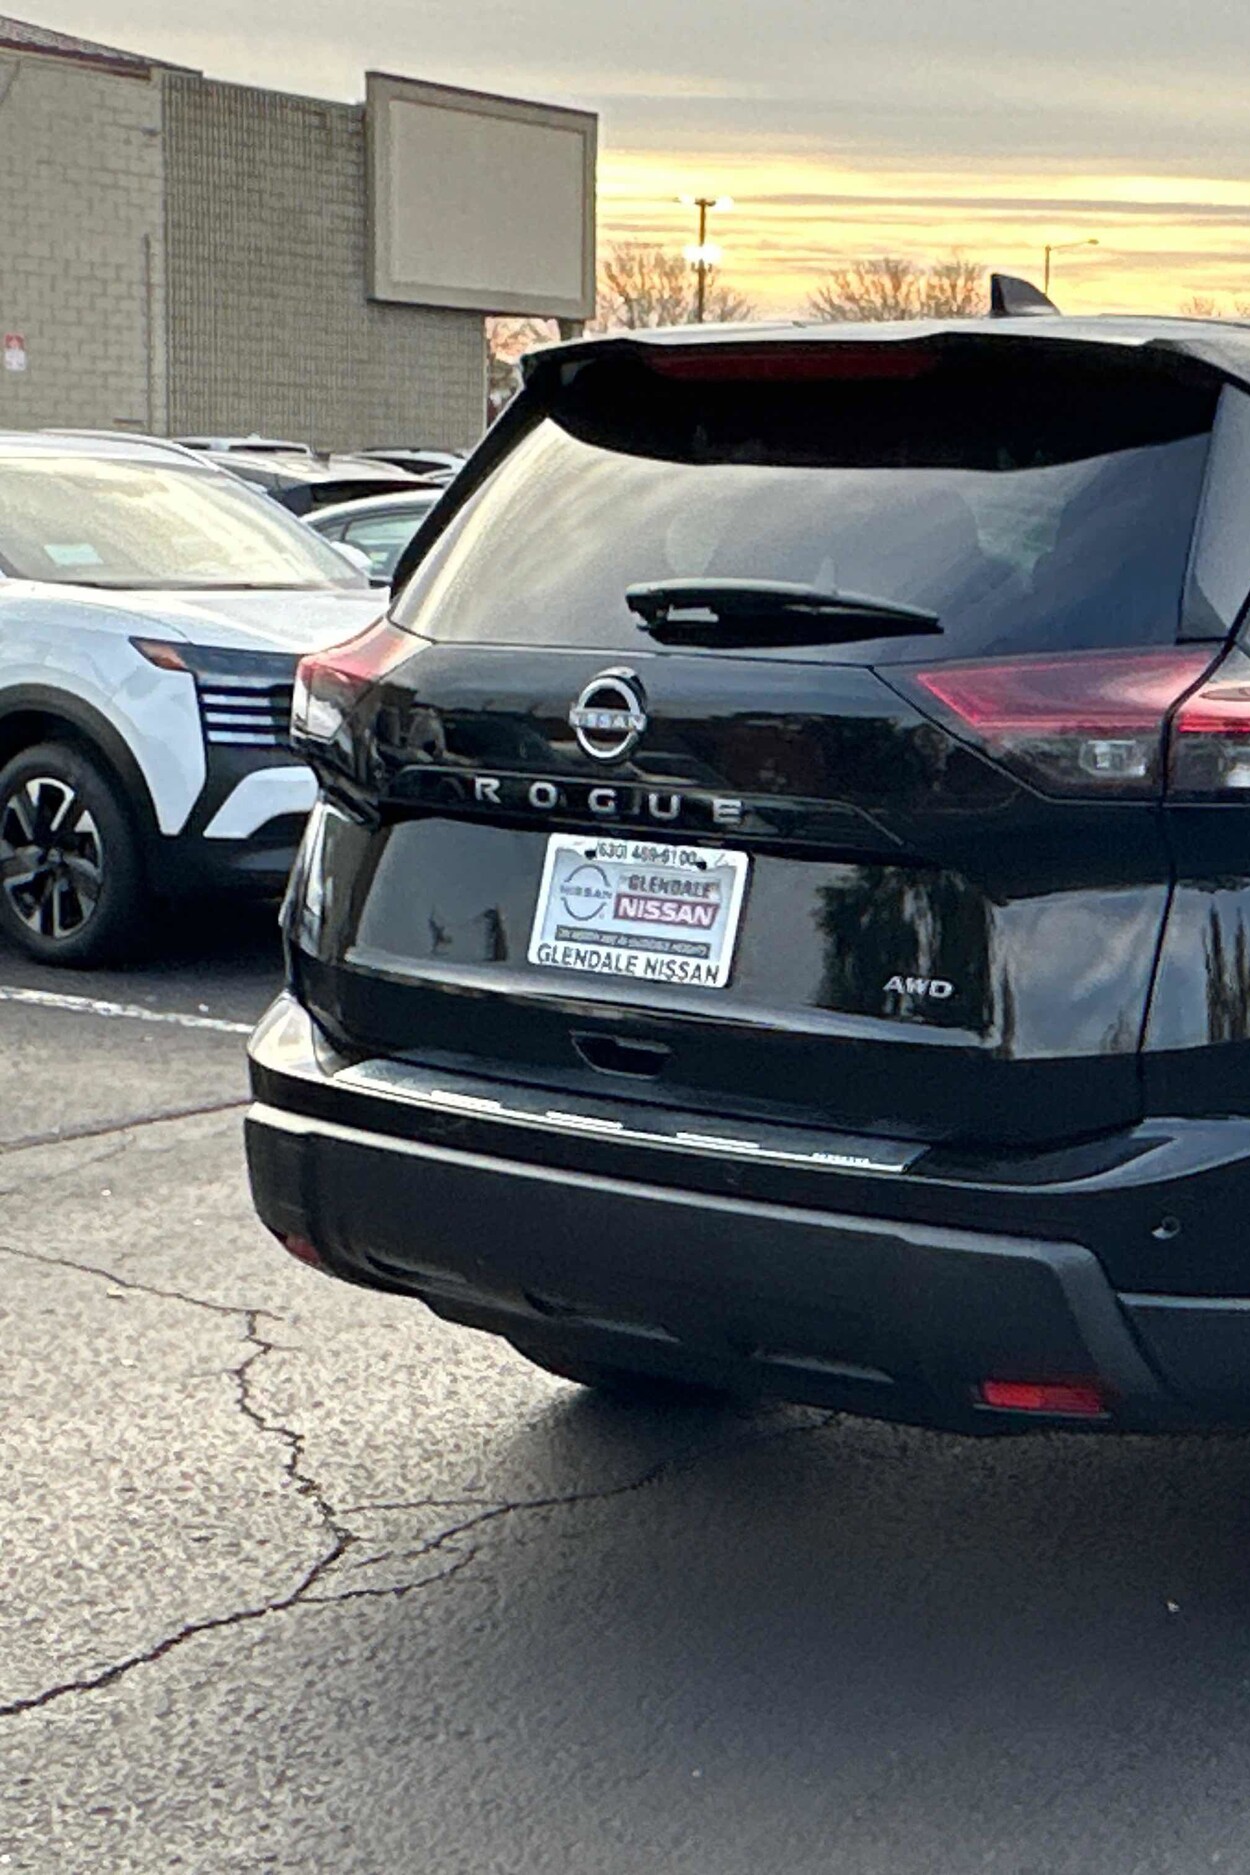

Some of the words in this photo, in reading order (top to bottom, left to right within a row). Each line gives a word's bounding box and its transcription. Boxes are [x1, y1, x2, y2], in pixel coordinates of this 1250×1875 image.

[569, 708, 646, 731] NISSAN
[474, 776, 743, 824] ROGUE
[627, 873, 712, 899] GLENDALE
[617, 897, 715, 926] NISSAN
[536, 942, 638, 974] GLENDALE
[643, 957, 720, 985] NISSAN
[882, 975, 954, 999] AWD
